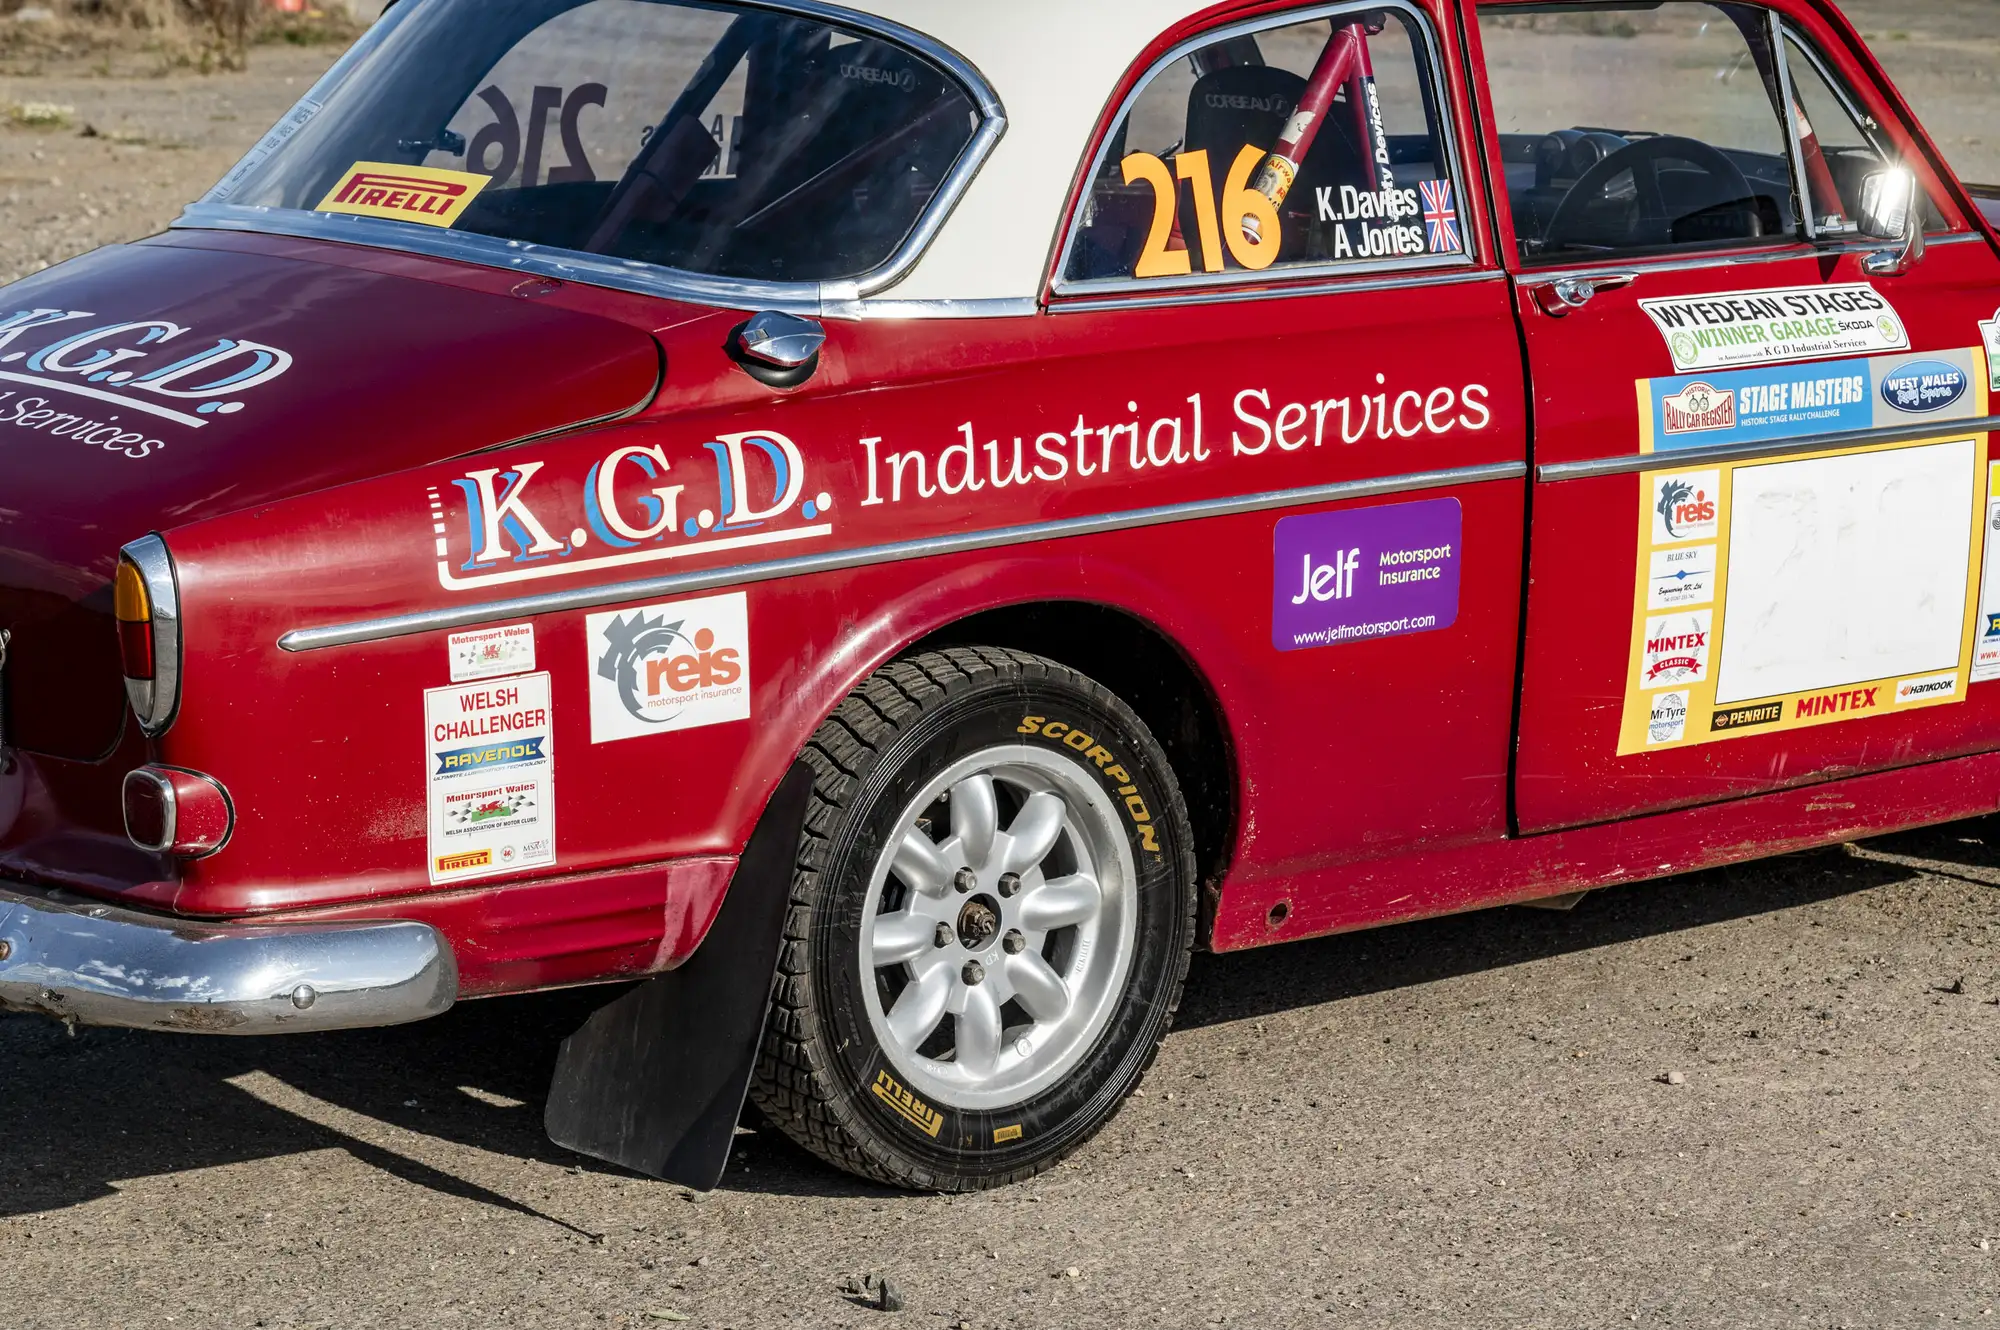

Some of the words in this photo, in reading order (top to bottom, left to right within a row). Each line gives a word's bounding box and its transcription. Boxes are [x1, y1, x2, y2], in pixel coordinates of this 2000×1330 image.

[840, 64, 899, 86] CORBEAU
[1205, 94, 1271, 111] CORBEAU
[1367, 83, 1389, 164] Devices
[333, 173, 467, 215] PIRELLI
[1315, 185, 1419, 221] K.Davies
[1121, 143, 1281, 278] 216
[1334, 224, 1353, 258] A
[1357, 222, 1424, 257] Jones
[1649, 297, 1787, 328] WYEDEAN
[1783, 290, 1884, 316] STAGES
[1691, 323, 1770, 349] WINNER
[1769, 317, 1841, 341] GARAGE
[1764, 346, 1773, 356] K
[1773, 345, 1781, 355] G
[1783, 344, 1790, 354] D
[1792, 341, 1832, 353] Industrial
[1832, 338, 1867, 350] Services
[1685, 385, 1711, 397] HISTORIC
[1888, 376, 1918, 391] WEST
[1922, 372, 1960, 387] WALES
[1740, 383, 1788, 414] STAGE
[1791, 375, 1863, 409] MASTERS
[1897, 386, 1919, 406] Rally
[1920, 384, 1953, 404] Spares
[1665, 400, 1686, 431] RALLY
[1686, 412, 1700, 429] CAR
[1701, 395, 1733, 427] REGISTER
[1741, 416, 1769, 427] HISTORIC
[1769, 414, 1788, 424] STAGE
[1789, 412, 1806, 422] RALLY
[1806, 408, 1840, 419] CHALLENGE
[0, 397, 165, 458] Services
[859, 393, 1211, 507] Industrial
[1232, 373, 1491, 457] Services
[452, 430, 832, 570] K.G.D.
[1675, 490, 1715, 524] reis
[1379, 544, 1451, 566] Motorsport
[1685, 550, 1698, 560] SKY
[1291, 547, 1360, 605] Jelf
[1379, 565, 1441, 585] Insurance
[452, 631, 502, 645] Motorsport
[504, 627, 530, 637] Wales
[1293, 614, 1436, 644] www.jelfmotorsport.com
[1647, 632, 1705, 654] MINTEX
[646, 628, 741, 697] reis
[1659, 658, 1689, 669] CLASSIC
[460, 687, 518, 712] WELSH
[647, 693, 698, 708] motorsport
[701, 685, 742, 699] insurance
[1795, 687, 1878, 719] MINTEX
[434, 709, 546, 742] CHALLENGER
[1649, 719, 1684, 730] motorsport
[1650, 709, 1664, 720] Mr
[1666, 707, 1686, 720] Tyre
[1729, 705, 1780, 725] PENRITE
[445, 743, 537, 768] RAVENOL
[446, 788, 502, 803] Motorsport
[506, 783, 535, 793] Wales
[1017, 716, 1160, 852] SCORPION
[445, 828, 463, 836] WELSH
[463, 823, 495, 833] ASSOCIATION
[521, 816, 537, 825] CLUBS
[439, 851, 488, 871] PIRELLI
[871, 1069, 944, 1138] PIRELLI
